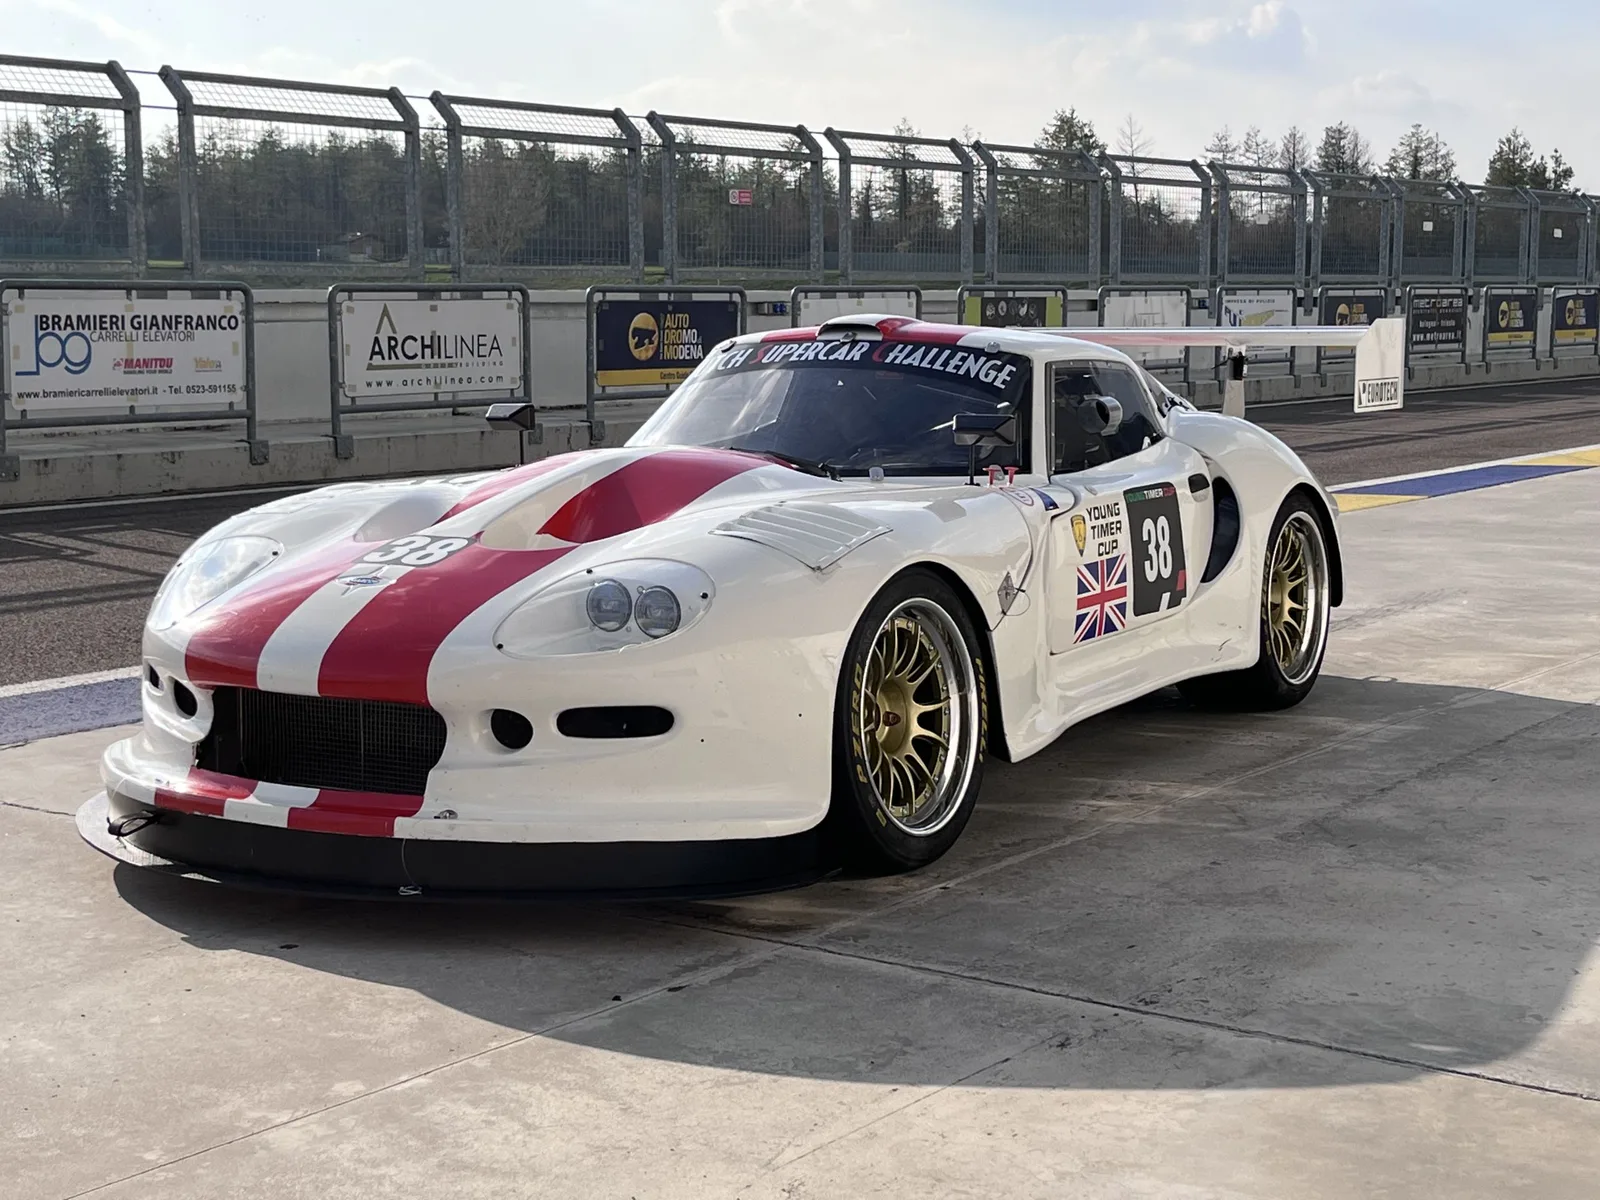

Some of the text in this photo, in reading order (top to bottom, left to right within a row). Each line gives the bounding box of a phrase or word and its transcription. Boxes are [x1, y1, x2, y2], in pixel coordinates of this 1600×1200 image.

[1413, 298, 1463, 308] metroarea
[39, 314, 239, 331] BRAMIERI GIANFRANCO
[664, 313, 690, 328] AUTO
[90, 331, 195, 342] CARRELLI ELEVATORI
[664, 329, 698, 344] DROMO
[369, 334, 504, 361] ARCHILINEA
[664, 344, 704, 360] MODENA
[124, 358, 174, 369] MANITOU
[716, 347, 754, 371] CH
[749, 341, 870, 365] SUPERCAR
[872, 342, 1017, 389] CHALLENGE
[168, 386, 184, 394] Tel.
[185, 384, 237, 394] 0523-591155
[365, 375, 505, 388] www.archilinea.com
[1367, 381, 1398, 403] EUROTECH
[1143, 488, 1164, 500] TIMER
[1086, 502, 1121, 521] YOUNG
[1090, 520, 1122, 540] TIMER
[363, 536, 469, 565] 38
[1097, 539, 1119, 557] CUP
[1142, 515, 1173, 582] 38
